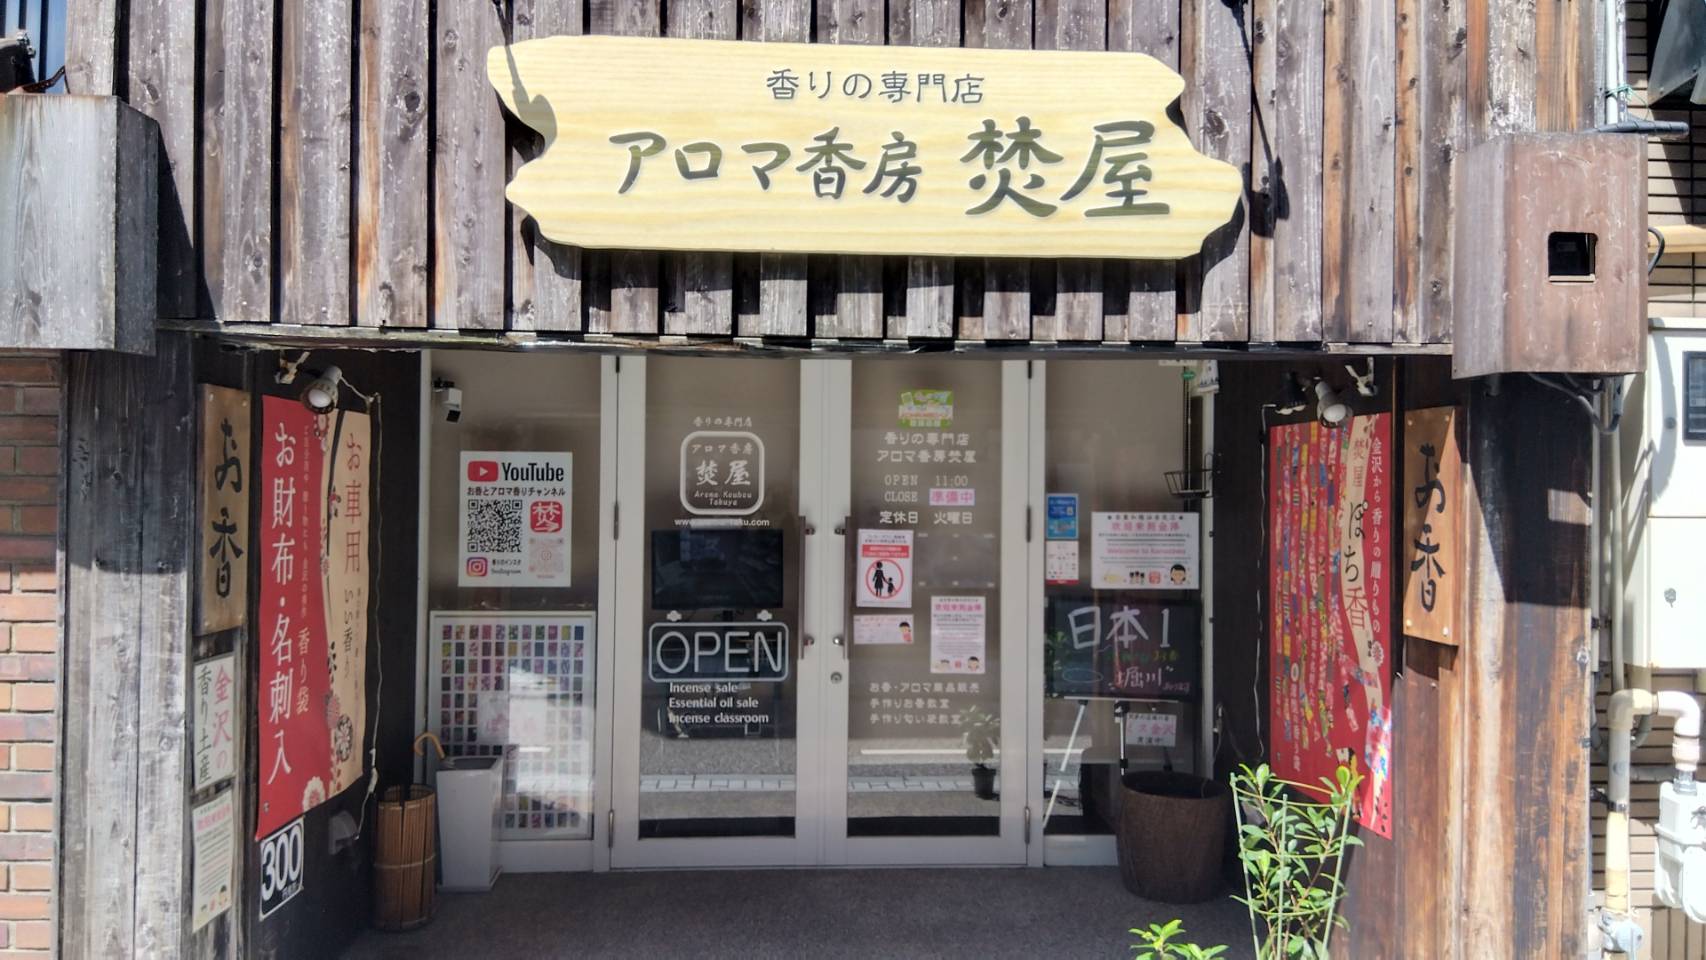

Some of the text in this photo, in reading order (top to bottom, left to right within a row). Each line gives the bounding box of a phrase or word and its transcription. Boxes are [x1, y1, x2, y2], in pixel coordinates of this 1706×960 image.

[766, 69, 985, 104] 香りの専門店
[608, 115, 1171, 219] アロマ香房 焚屋
[692, 415, 753, 428] 香りの専門店
[692, 442, 754, 456] アロマ香房
[883, 431, 970, 446] 香りの専門店
[877, 449, 977, 463] アロマ香房焚屋
[501, 462, 565, 482] YouTube
[695, 459, 752, 486] 焚屋
[884, 474, 969, 487] OPEN 11:00
[344, 432, 362, 574] お車用
[466, 486, 566, 497] お香とアロマ香りチャンネル
[884, 490, 919, 502] CLOSE
[209, 416, 244, 598] お香
[879, 510, 973, 524] 定休日 火曜日
[1370, 436, 1384, 633] 金沢から香りの贈りもの
[1410, 441, 1447, 613] お香
[1344, 501, 1369, 630] ぽち香
[267, 421, 296, 786] お財布・名刺入
[656, 631, 783, 674] OPEN
[296, 626, 311, 716] 香り袋
[669, 682, 738, 694] Incense sale
[668, 696, 759, 708] Essential oil sale
[211, 664, 233, 770] 金沢の
[668, 712, 770, 724] Incense classroom
[261, 823, 301, 901] 300
